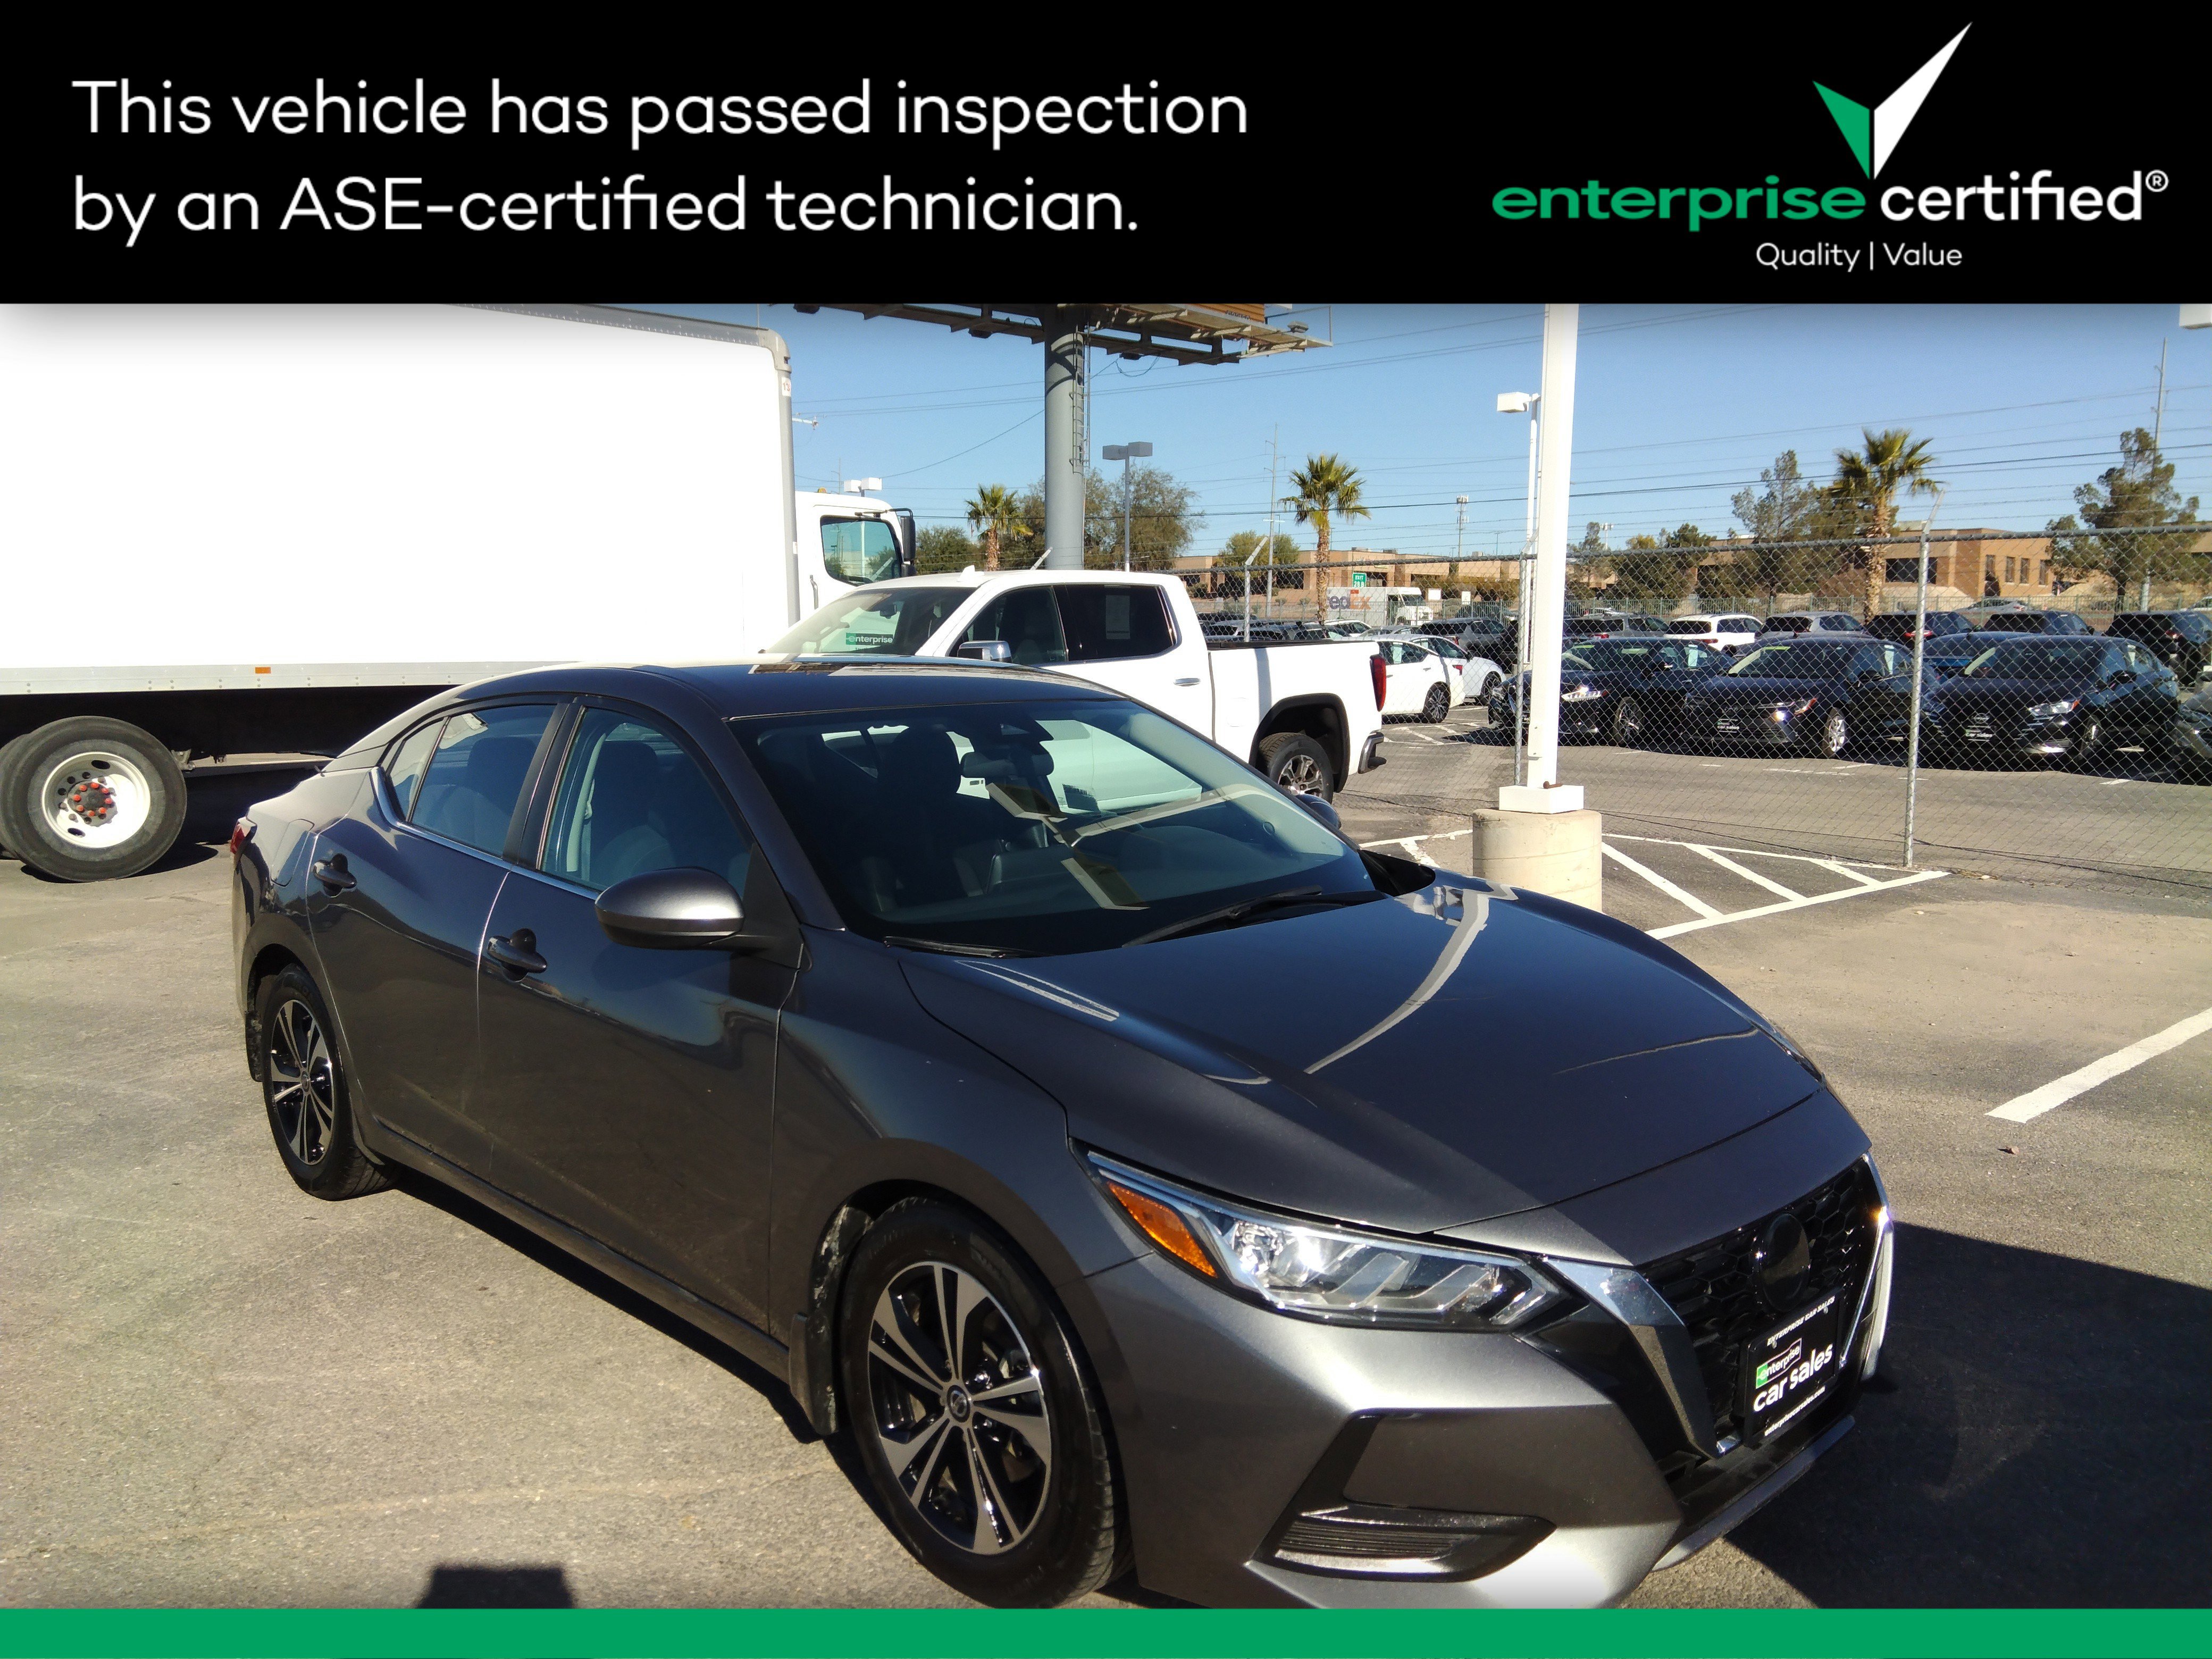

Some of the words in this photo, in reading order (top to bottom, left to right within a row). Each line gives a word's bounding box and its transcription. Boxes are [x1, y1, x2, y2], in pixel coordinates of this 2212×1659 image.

[849, 635, 893, 644] enterprise
[1766, 1316, 1805, 1346] ENTERPRISE
[1805, 1308, 1817, 1321] CAR
[1817, 1295, 1836, 1312] SALES
[1753, 1377, 1787, 1412] car
[1789, 1343, 1833, 1389] sales
[1759, 1346, 1800, 1380] enterprise
